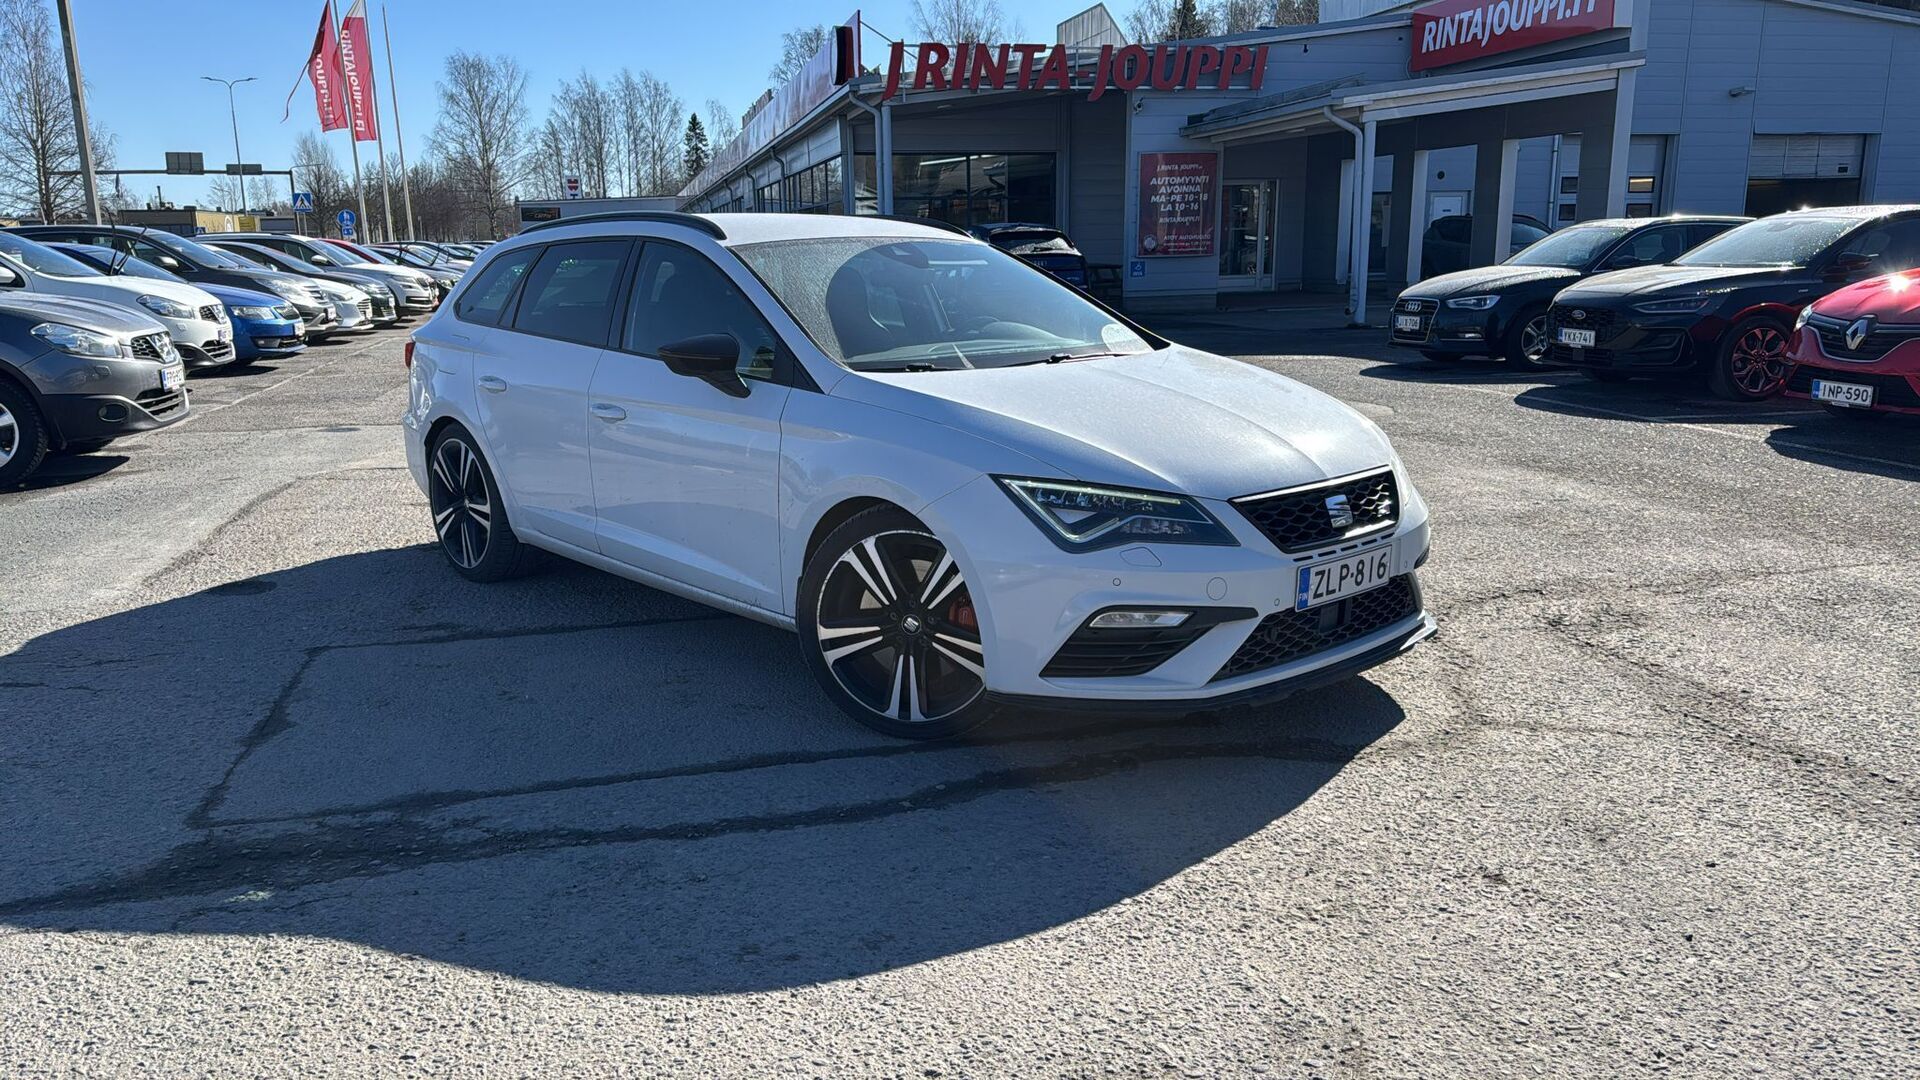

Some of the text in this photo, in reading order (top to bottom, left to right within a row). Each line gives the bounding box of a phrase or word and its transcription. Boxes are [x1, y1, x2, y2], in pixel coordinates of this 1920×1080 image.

[913, 43, 1270, 101] RINTA-JOUPPI
[1150, 175, 1210, 186] AUTOMYYNTI
[1158, 184, 1202, 194] AVOINNA
[1150, 194, 1183, 203] MA-PE
[1160, 202, 1200, 212] LA 10-16
[1822, 384, 1869, 402] INP-590
[1313, 552, 1387, 600] ZLP-816
